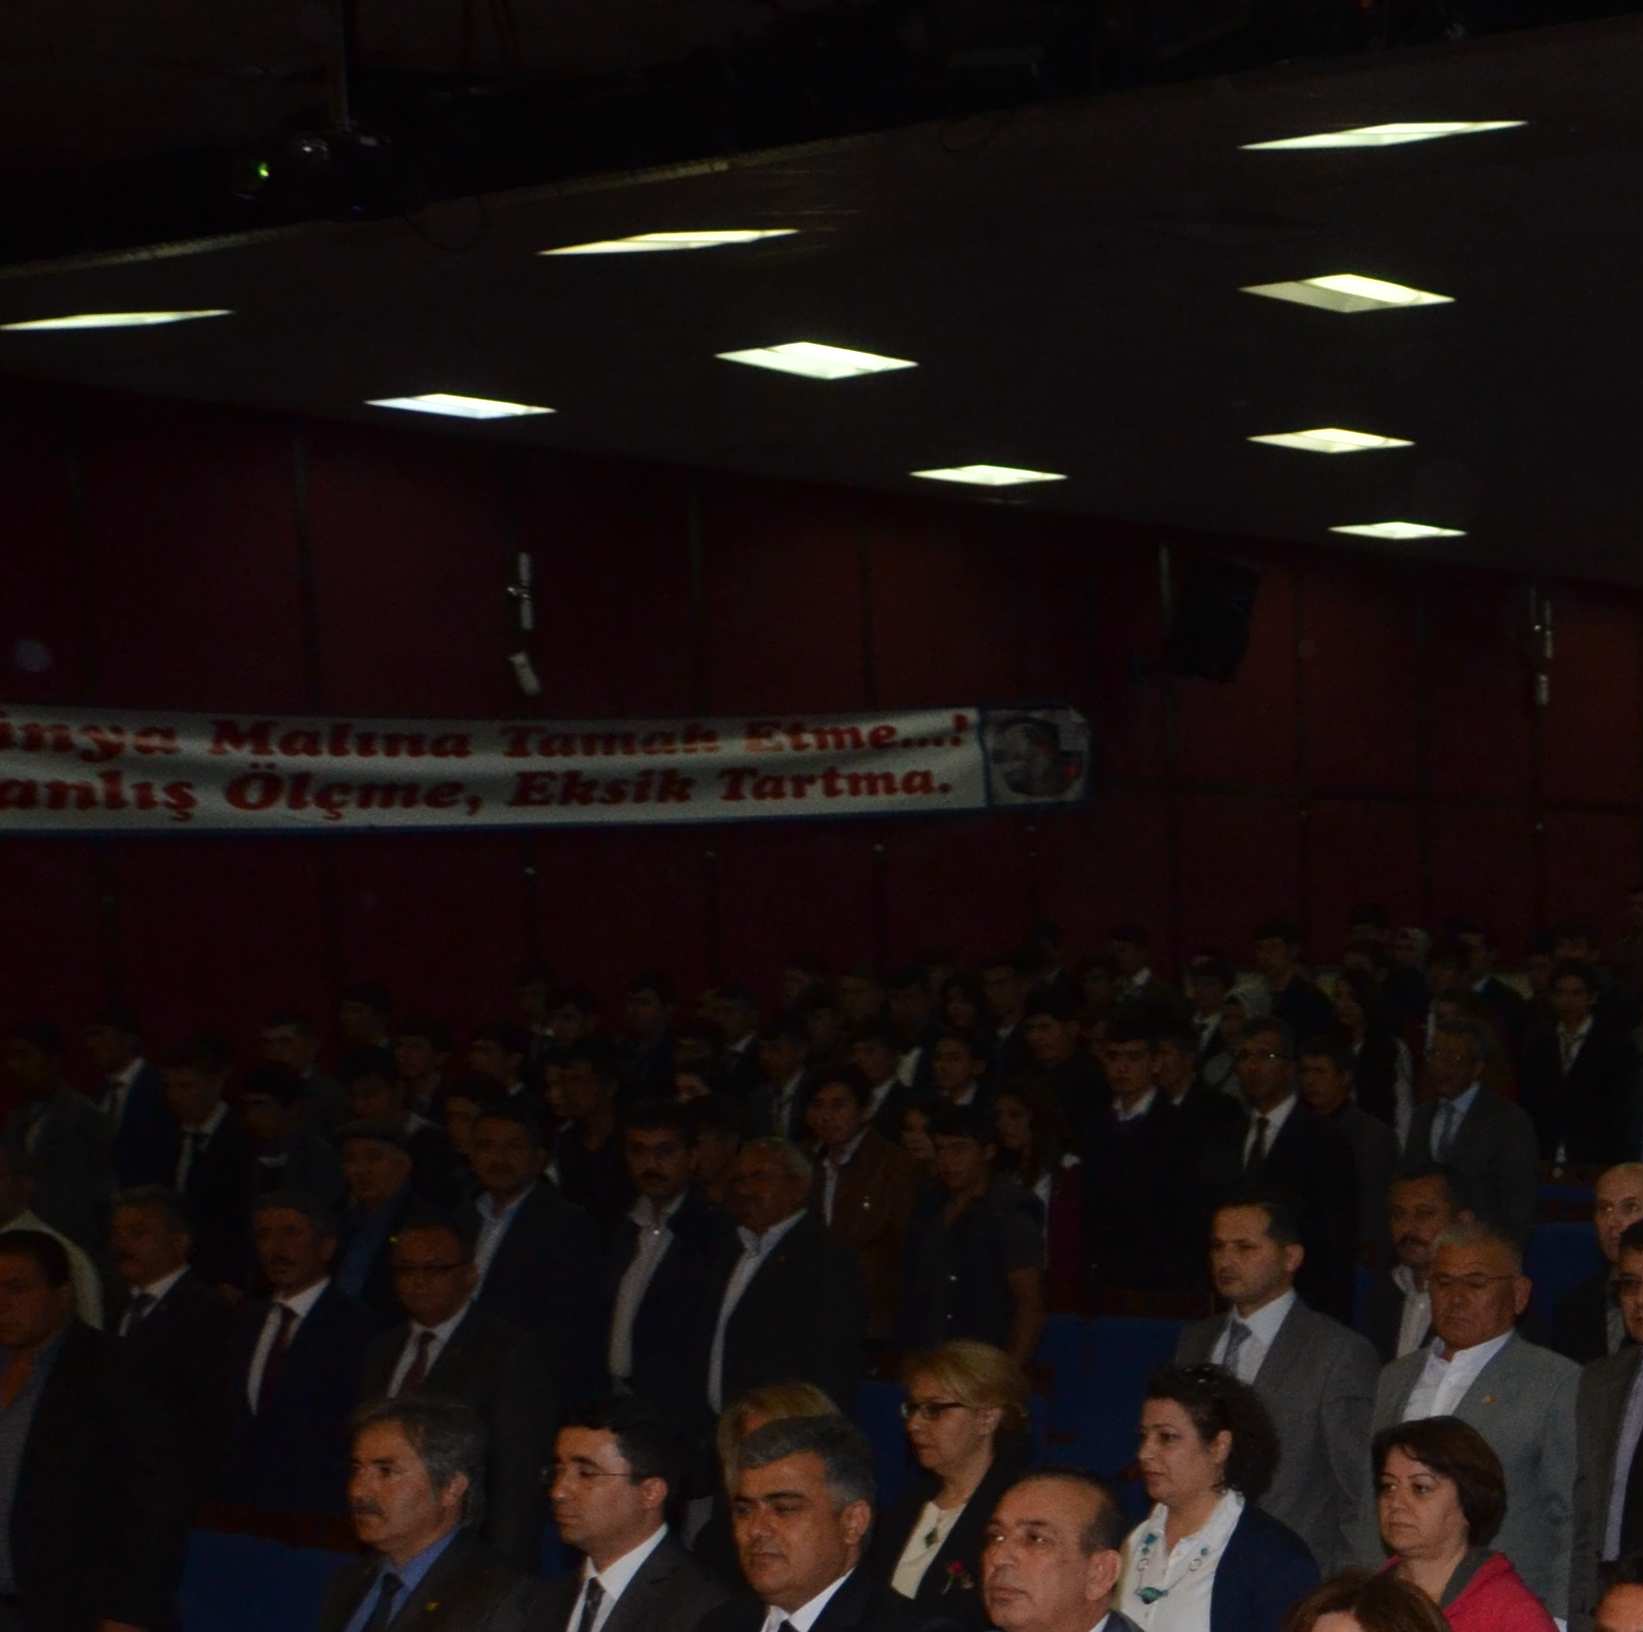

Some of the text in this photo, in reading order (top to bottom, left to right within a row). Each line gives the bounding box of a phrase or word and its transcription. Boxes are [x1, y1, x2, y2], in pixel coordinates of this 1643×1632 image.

[210, 719, 472, 757] Malına
[225, 763, 481, 820] Ölçme,
[508, 770, 692, 807] Eksik
[719, 766, 953, 802] Tartma.
